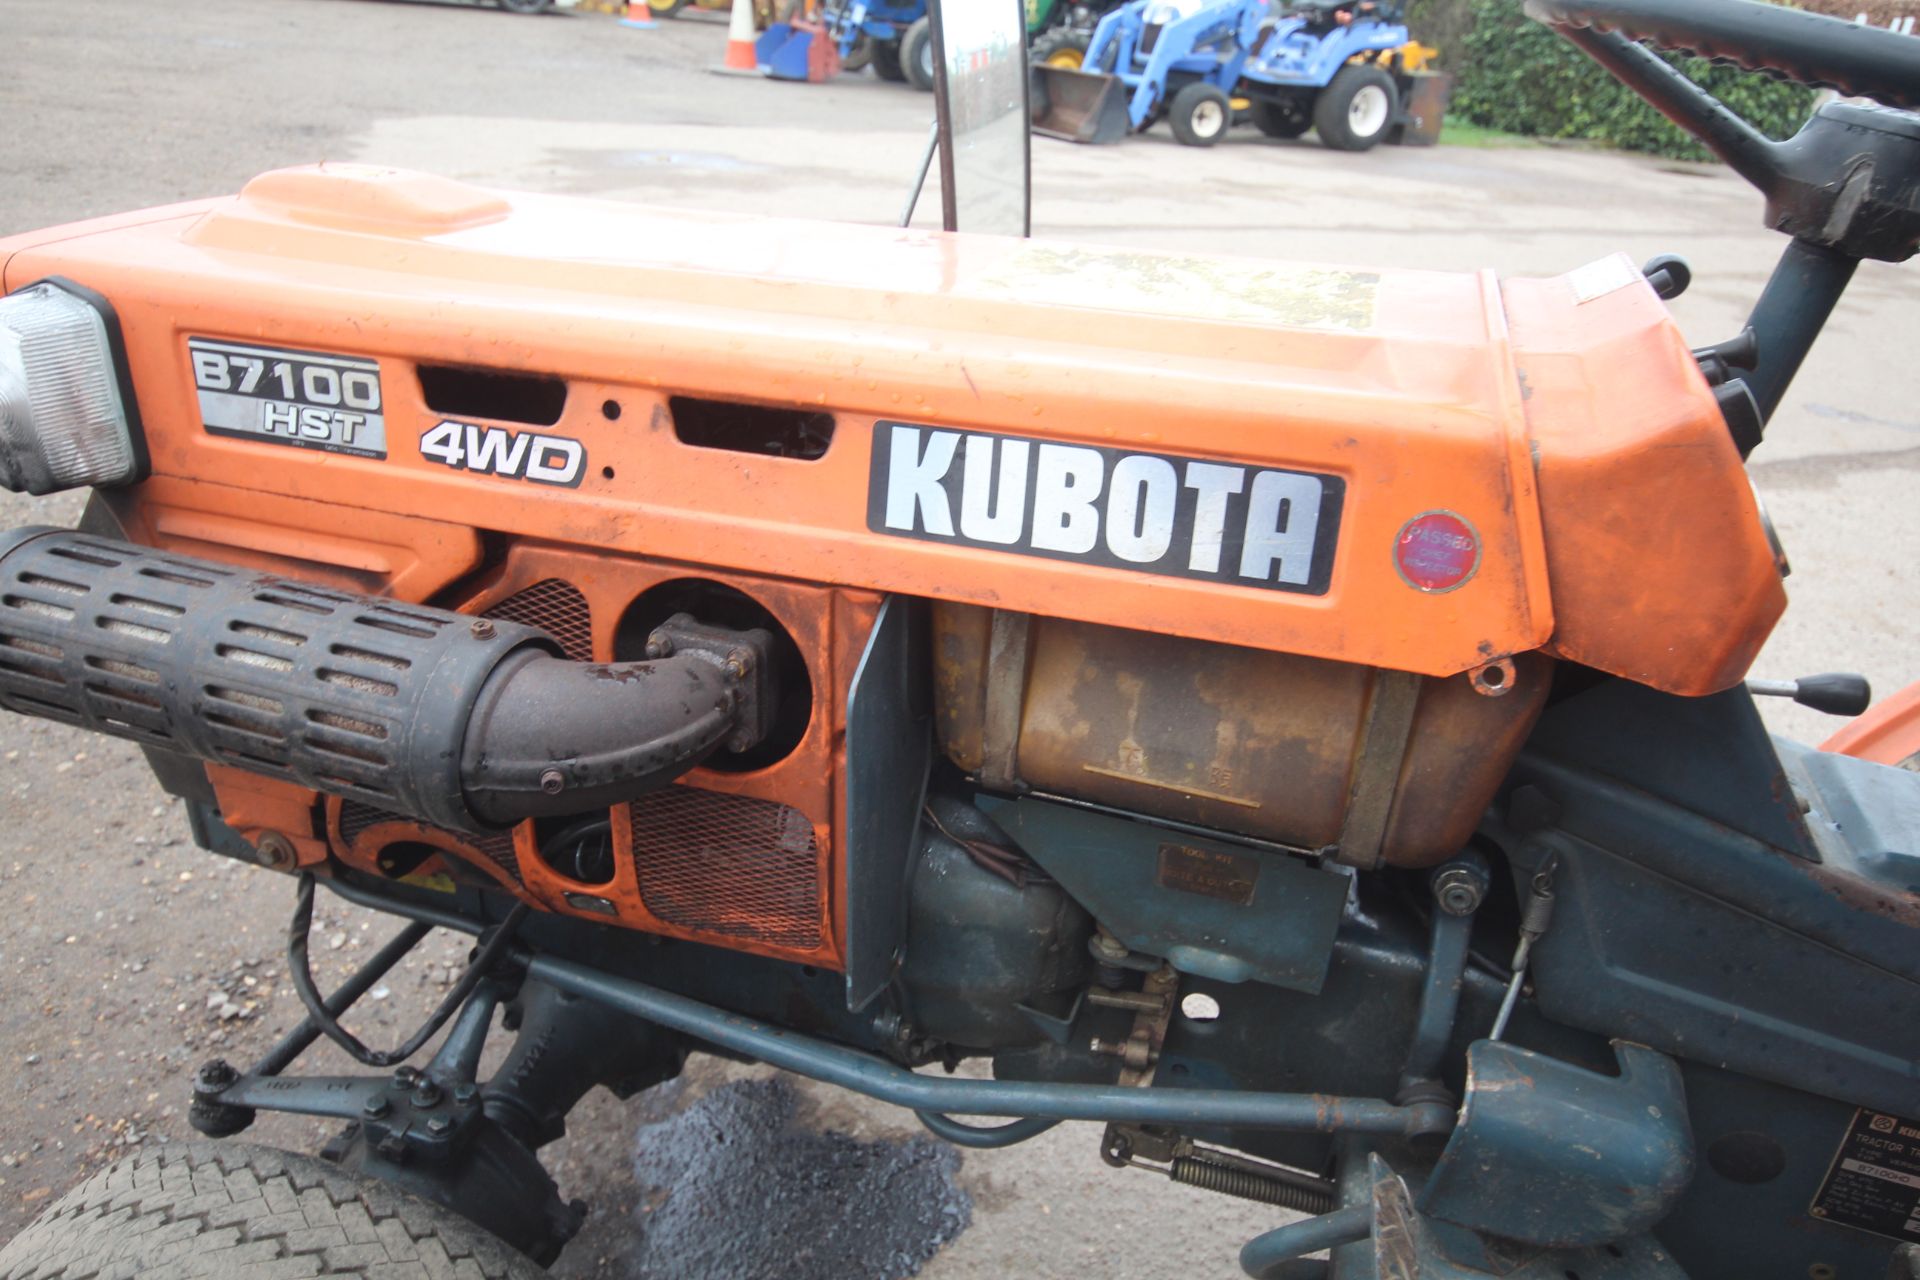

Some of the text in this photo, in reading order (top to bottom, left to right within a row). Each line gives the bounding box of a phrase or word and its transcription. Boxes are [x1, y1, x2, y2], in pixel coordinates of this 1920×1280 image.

[195, 351, 381, 411] B7100
[263, 402, 366, 444] HST
[420, 420, 587, 488] 4WD
[885, 426, 1322, 585] KUBOTA
[1406, 526, 1474, 551] PASSED
[1856, 1134, 1904, 1153] TRACTOR
